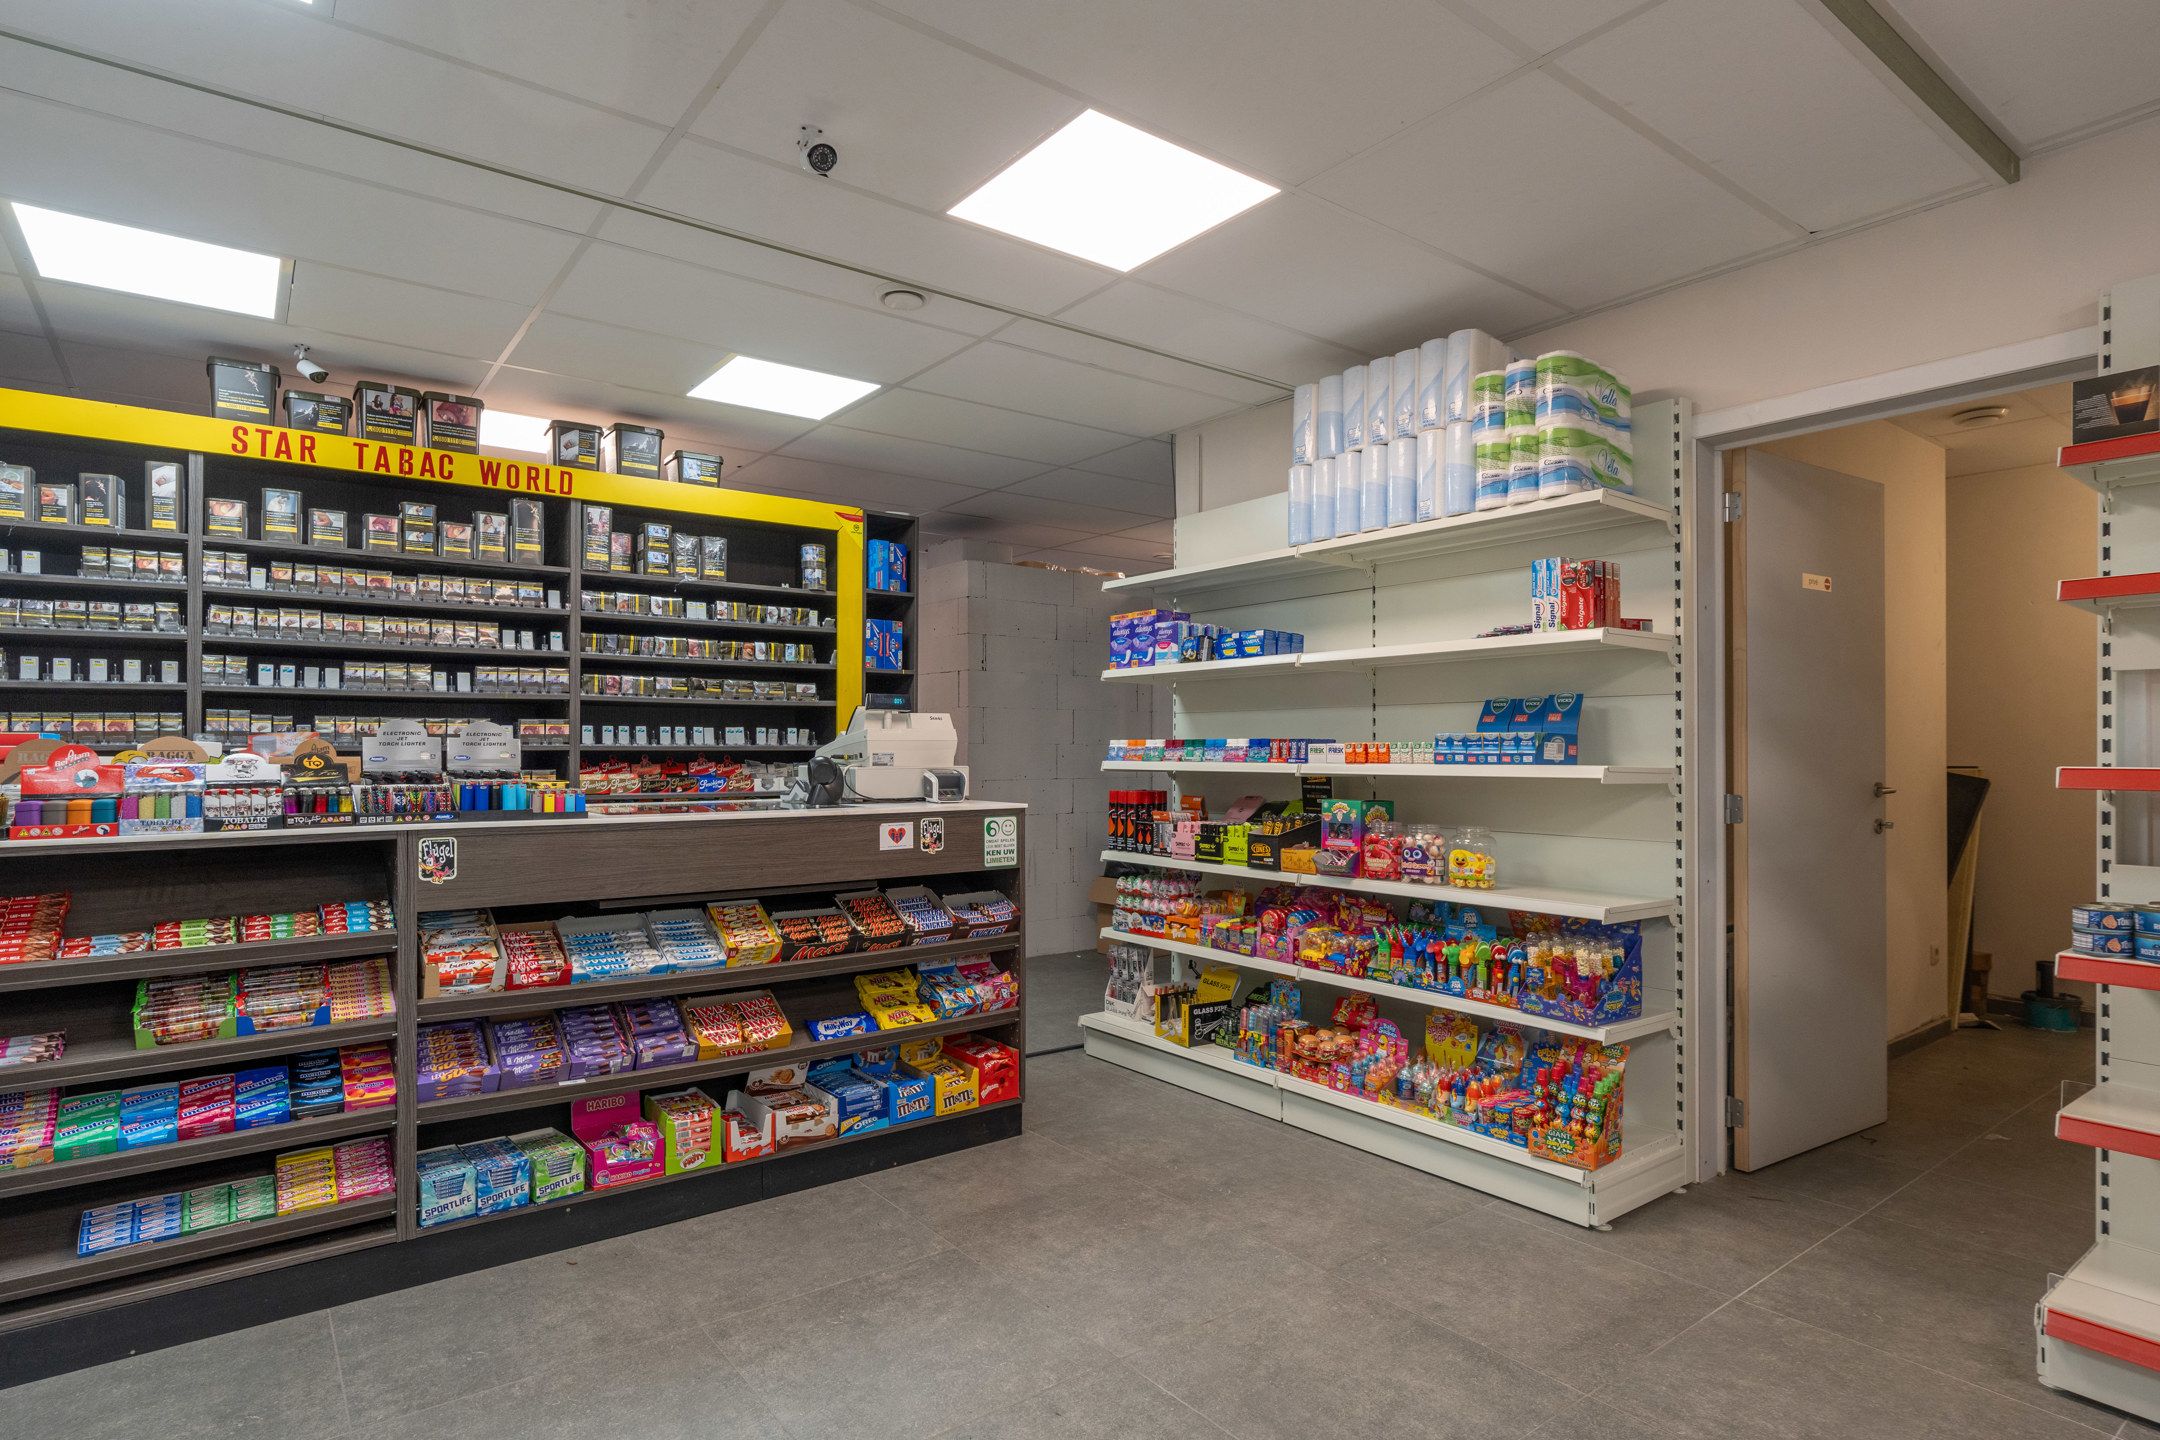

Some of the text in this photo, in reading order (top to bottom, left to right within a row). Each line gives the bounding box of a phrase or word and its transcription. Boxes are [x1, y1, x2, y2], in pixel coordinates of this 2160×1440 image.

[231, 425, 573, 496] STAR TABAC WORLD
[422, 840, 454, 863] Flügel
[897, 897, 927, 905] SNICKERS
[901, 903, 932, 911] SNICKERS
[917, 915, 948, 923] SNICKERS
[921, 921, 952, 931] SNICKERS
[790, 930, 817, 939] Mars
[824, 926, 852, 935] Mars
[790, 941, 848, 961] Mars
[867, 940, 901, 951] Mars
[1202, 978, 1231, 992] GLASS PIPE
[1194, 1007, 1213, 1015] GLASS
[508, 1043, 528, 1053] Milka
[514, 1054, 535, 1064] Milka
[816, 1060, 836, 1070] OREO
[513, 1063, 533, 1074] Milka
[184, 1077, 231, 1094] mentos
[238, 1074, 284, 1092] mentos
[126, 1089, 175, 1106] mentos
[301, 1088, 333, 1096] mentos
[943, 1089, 974, 1108] m&m's
[64, 1094, 116, 1113] mentos
[182, 1100, 230, 1117] mentos
[587, 1096, 625, 1112] HARIBO
[61, 1118, 114, 1138] mentos
[124, 1116, 175, 1134] mentos
[854, 1117, 878, 1130] OREO
[1549, 1130, 1570, 1139] GIANT
[538, 1174, 581, 1195] SPORTLIFE
[480, 1184, 526, 1206] SPORTLIFE
[425, 1195, 472, 1218] SPORTLIFE
